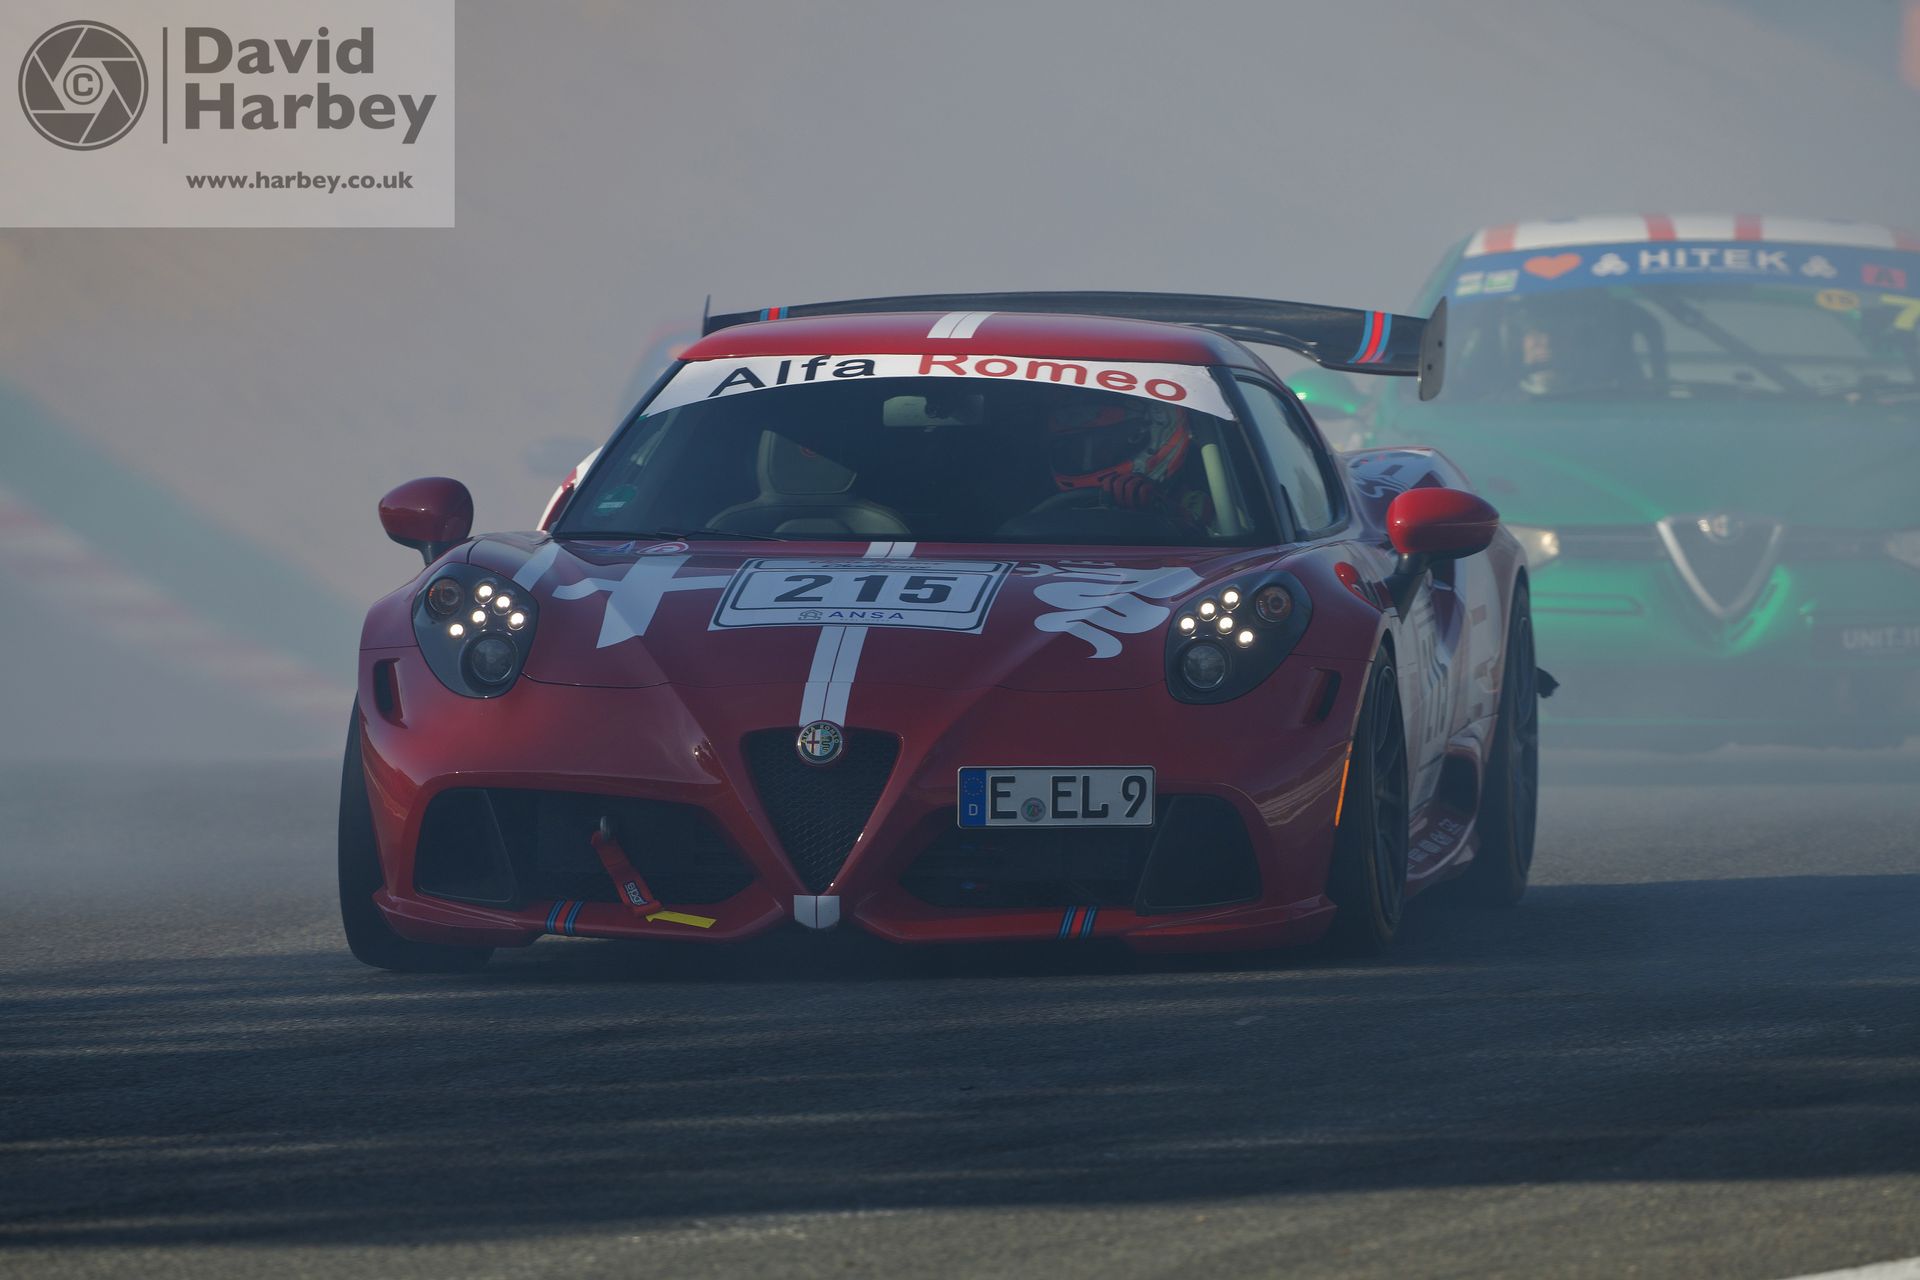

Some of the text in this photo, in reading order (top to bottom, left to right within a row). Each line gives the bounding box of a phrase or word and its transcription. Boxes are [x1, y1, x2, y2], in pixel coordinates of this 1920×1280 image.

[1638, 247, 1789, 271] HITEK
[707, 353, 1187, 402] Alfa Romeo
[774, 574, 958, 604] 215
[828, 610, 904, 620] ANSA
[968, 804, 978, 816] D
[990, 775, 1147, 819] E EL 9
